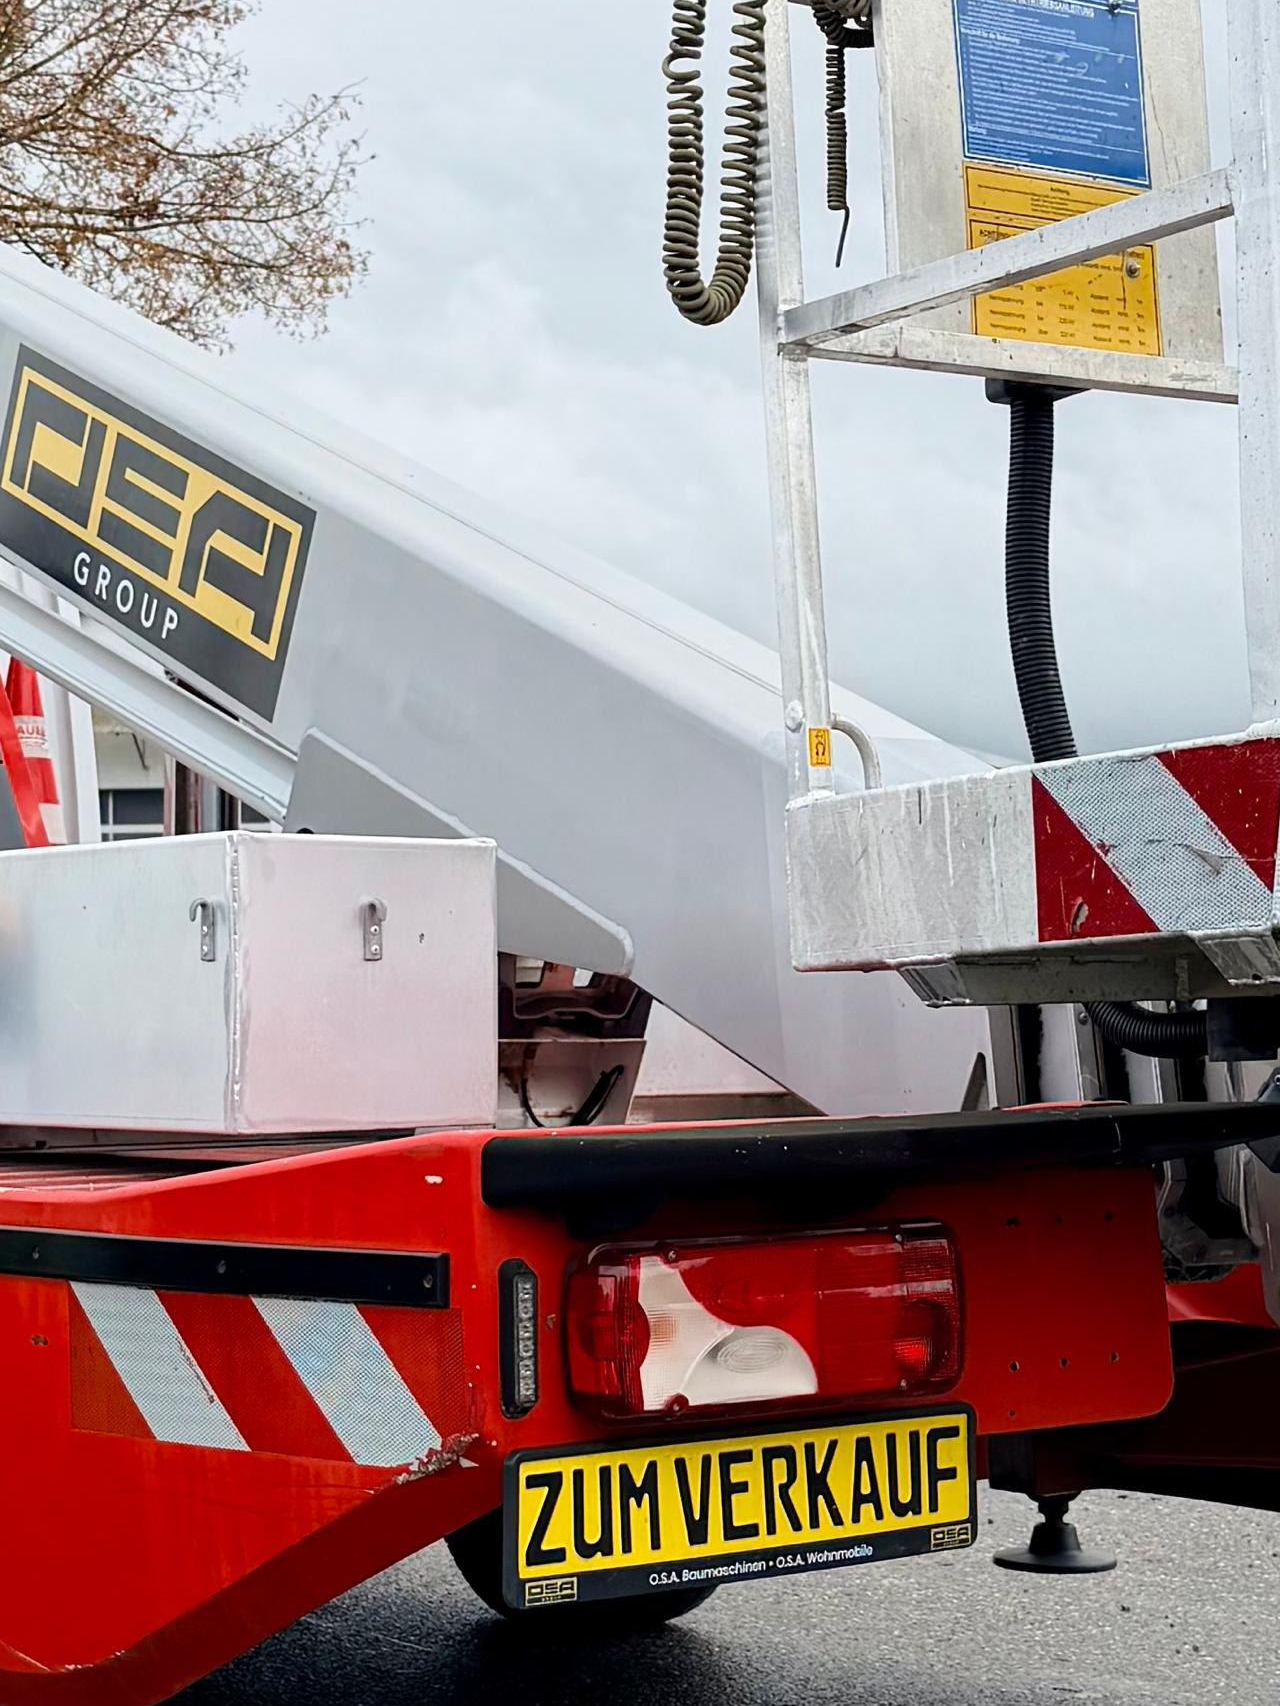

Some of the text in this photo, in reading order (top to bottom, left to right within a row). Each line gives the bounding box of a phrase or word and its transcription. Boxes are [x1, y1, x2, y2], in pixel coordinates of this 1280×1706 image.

[73, 551, 180, 640] GROUP
[524, 1425, 961, 1568] ZUM VERKAUF
[648, 1543, 873, 1586] O.S.A. Baumaschinen O.S.A. Wohnmobile
